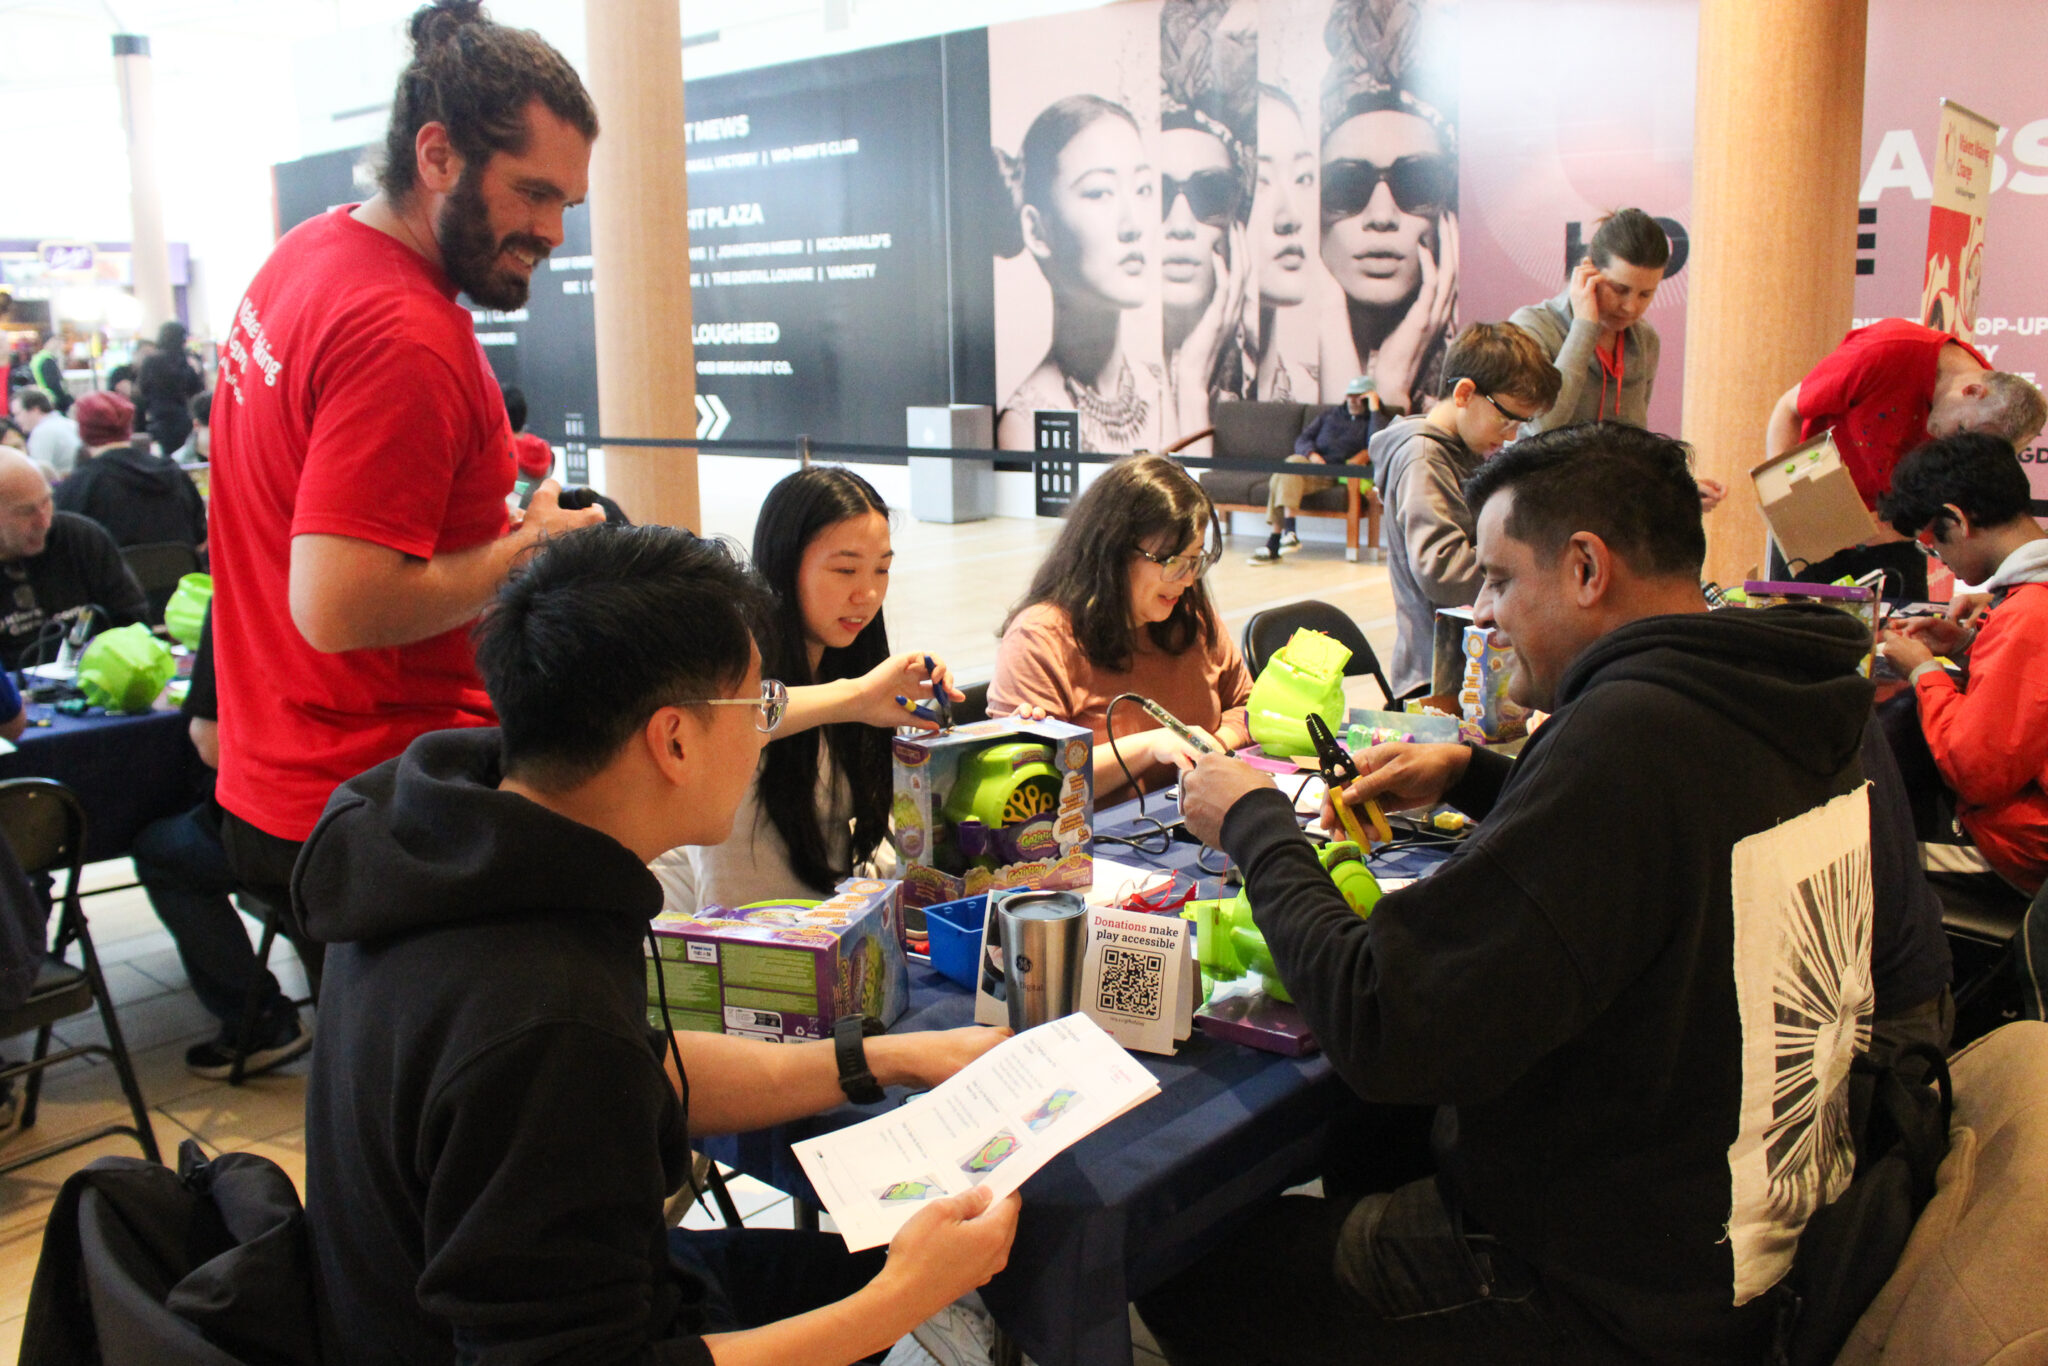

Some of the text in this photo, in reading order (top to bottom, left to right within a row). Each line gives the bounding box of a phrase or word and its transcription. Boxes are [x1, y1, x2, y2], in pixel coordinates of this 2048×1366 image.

[707, 202, 765, 228] PLAZA
[815, 233, 892, 252] MCDONALD'S
[691, 322, 781, 345] LOUGHEED
[1974, 316, 2048, 336] OP-UP
[773, 360, 794, 374] CO.
[1094, 916, 1179, 938] Donations make
[1096, 929, 1176, 950] play accessible
